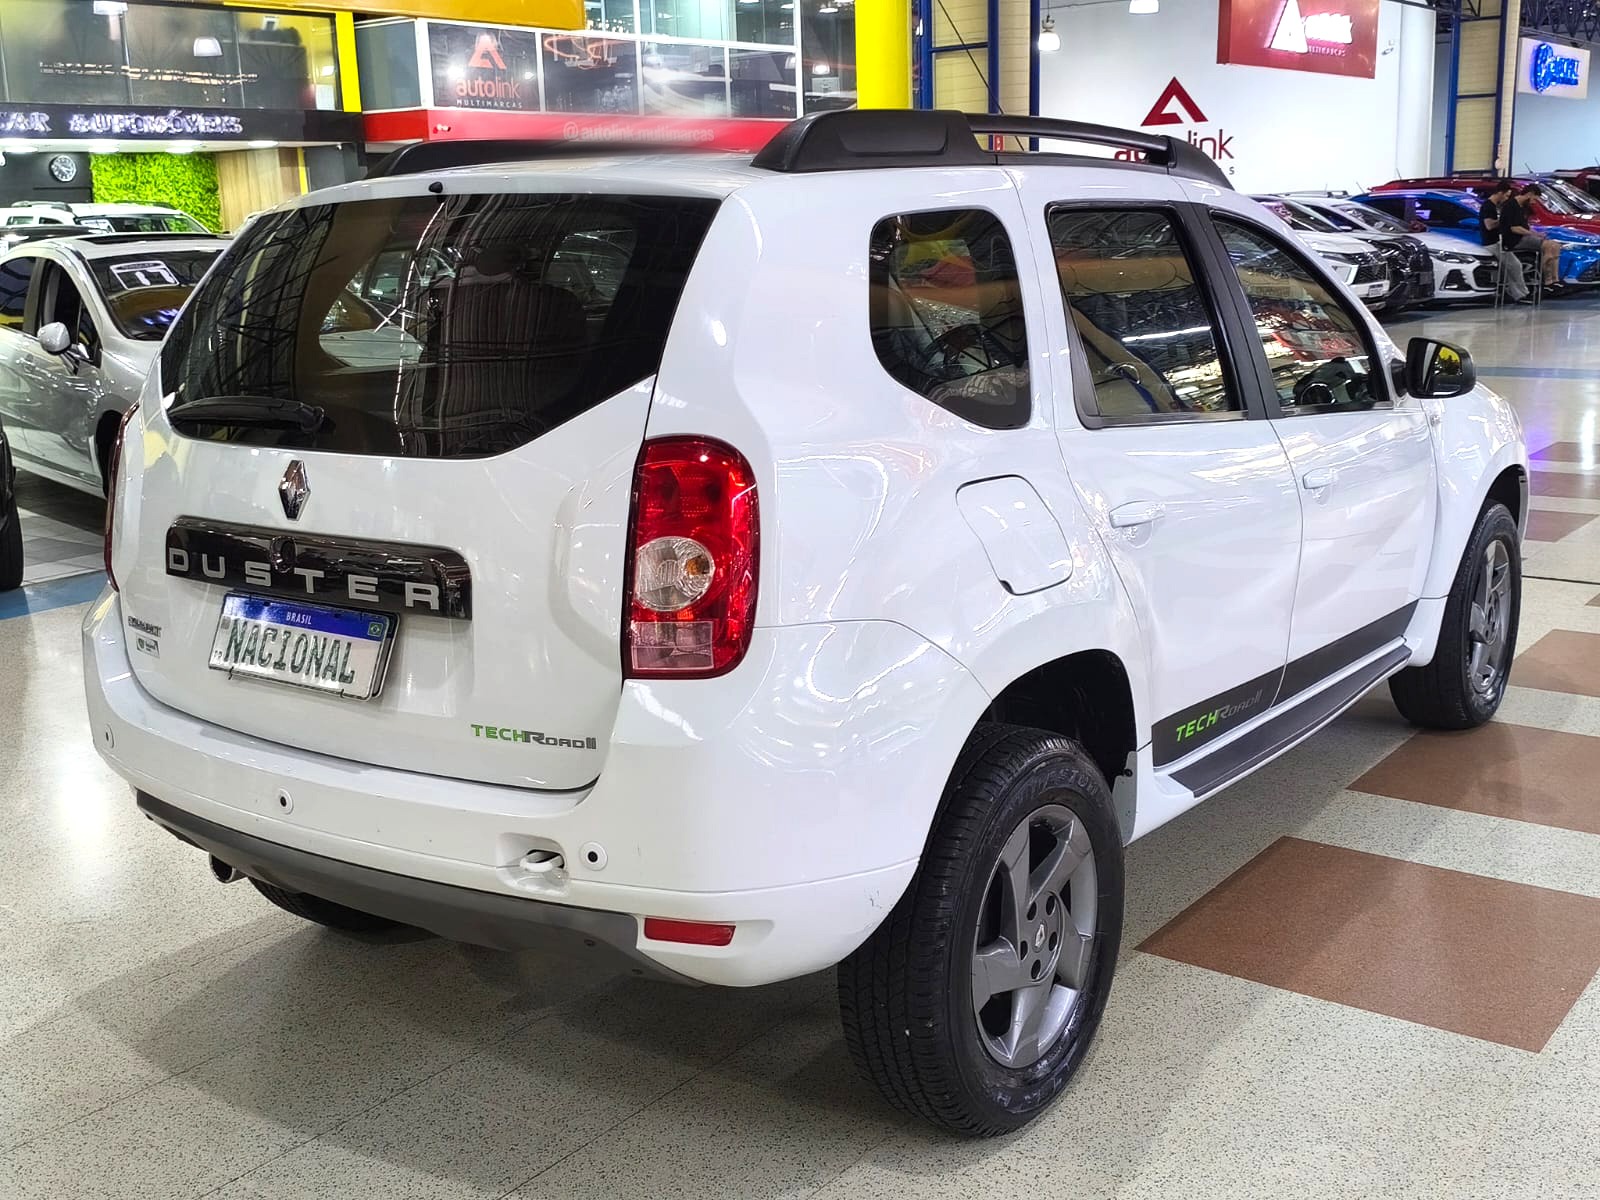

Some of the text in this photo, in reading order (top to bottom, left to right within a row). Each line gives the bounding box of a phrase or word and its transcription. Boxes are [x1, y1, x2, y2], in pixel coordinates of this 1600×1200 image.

[455, 76, 522, 99] autolink
[456, 99, 523, 109] MULTIMARCAS
[168, 546, 441, 611] DUSTER
[286, 611, 313, 625] BRASIL
[223, 617, 356, 685] NACIONAL
